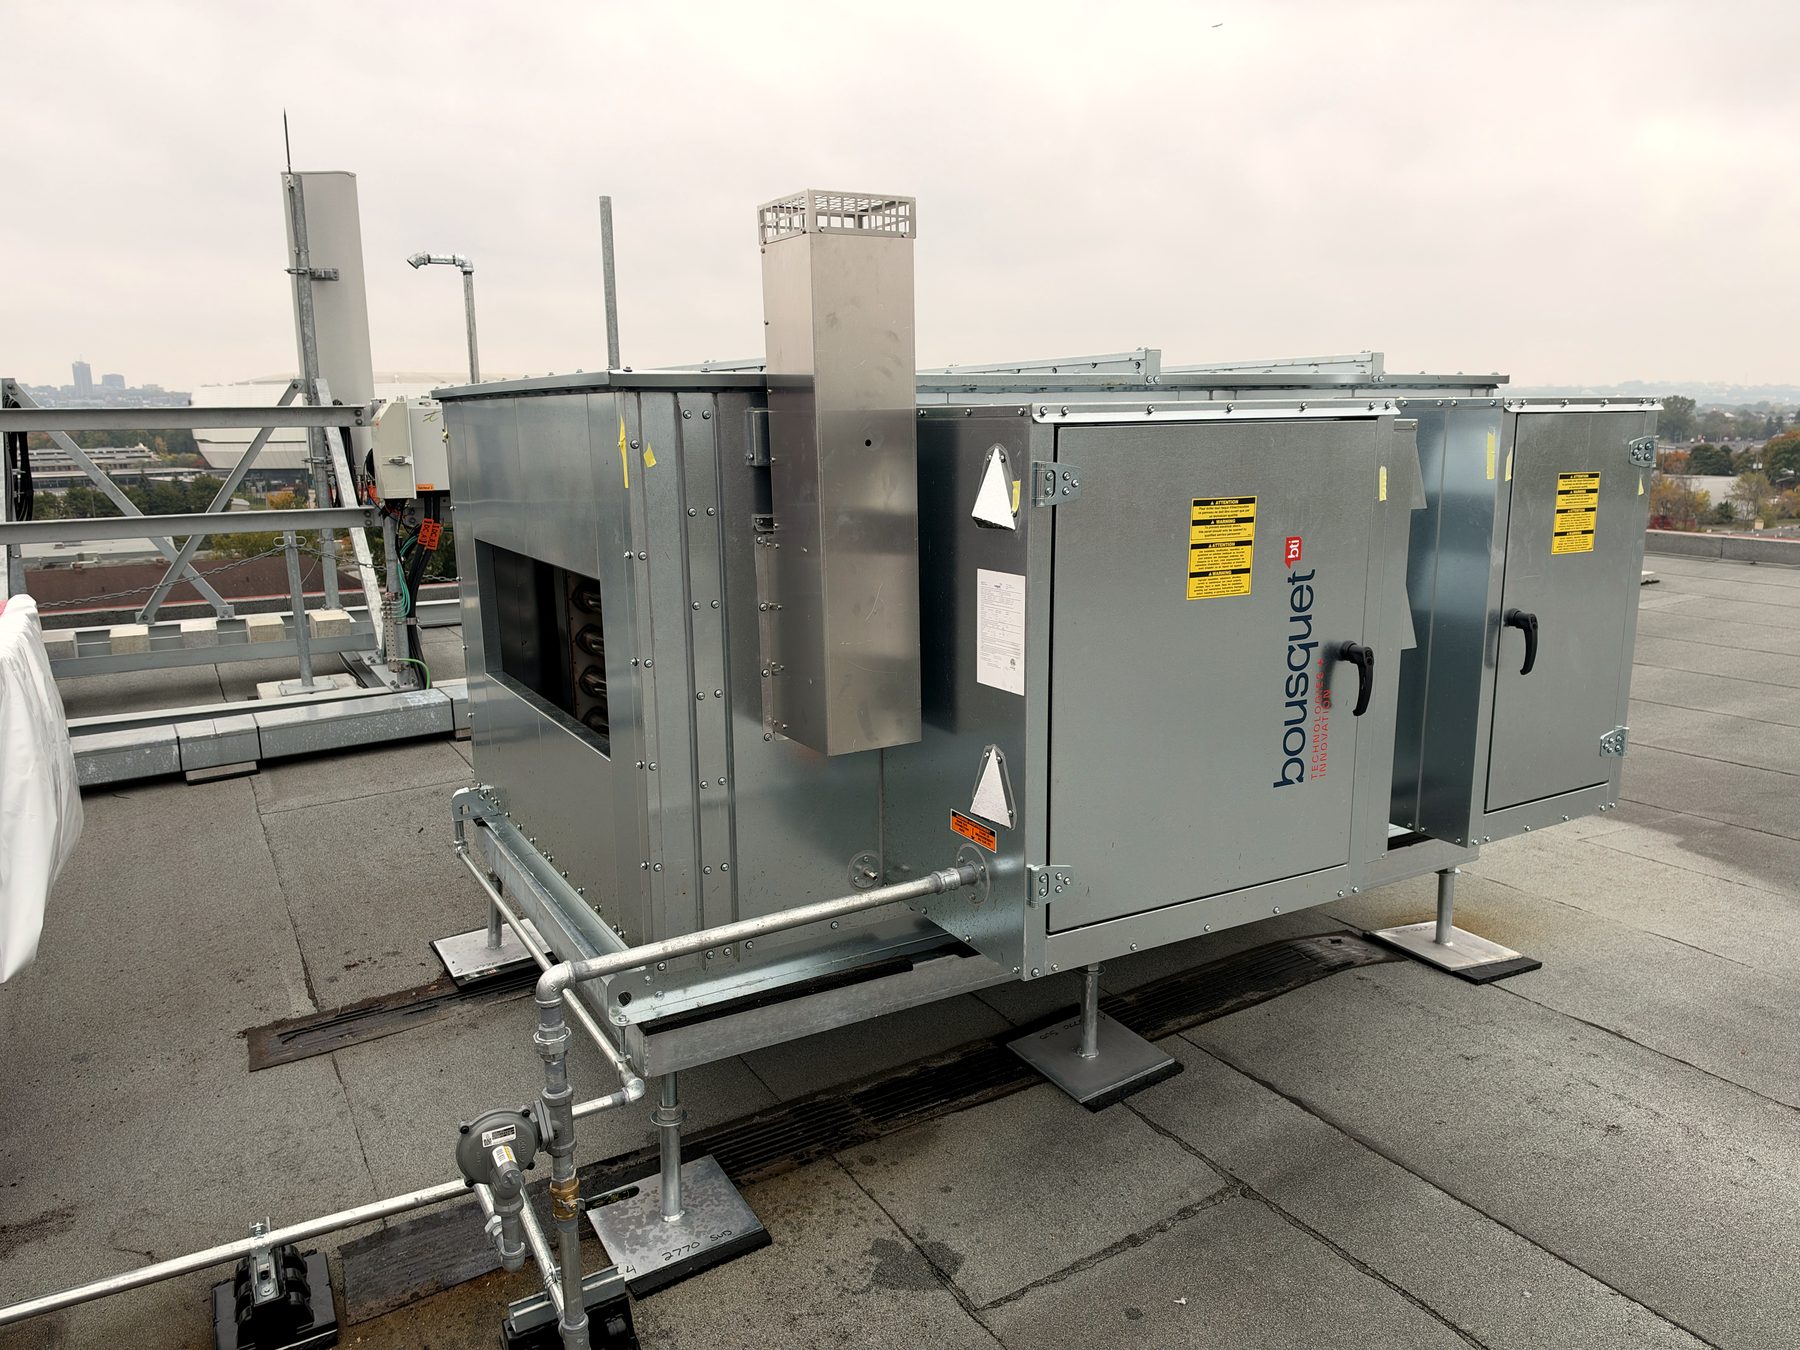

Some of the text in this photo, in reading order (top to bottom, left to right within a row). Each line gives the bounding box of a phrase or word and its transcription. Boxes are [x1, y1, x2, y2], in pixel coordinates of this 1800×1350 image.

[1288, 539, 1300, 559] bti
[1273, 569, 1319, 788] bousquet
[1311, 671, 1325, 780] TECHNOLOGIES
[1319, 689, 1332, 777] INNOVATION
[661, 1241, 701, 1261] 2770
